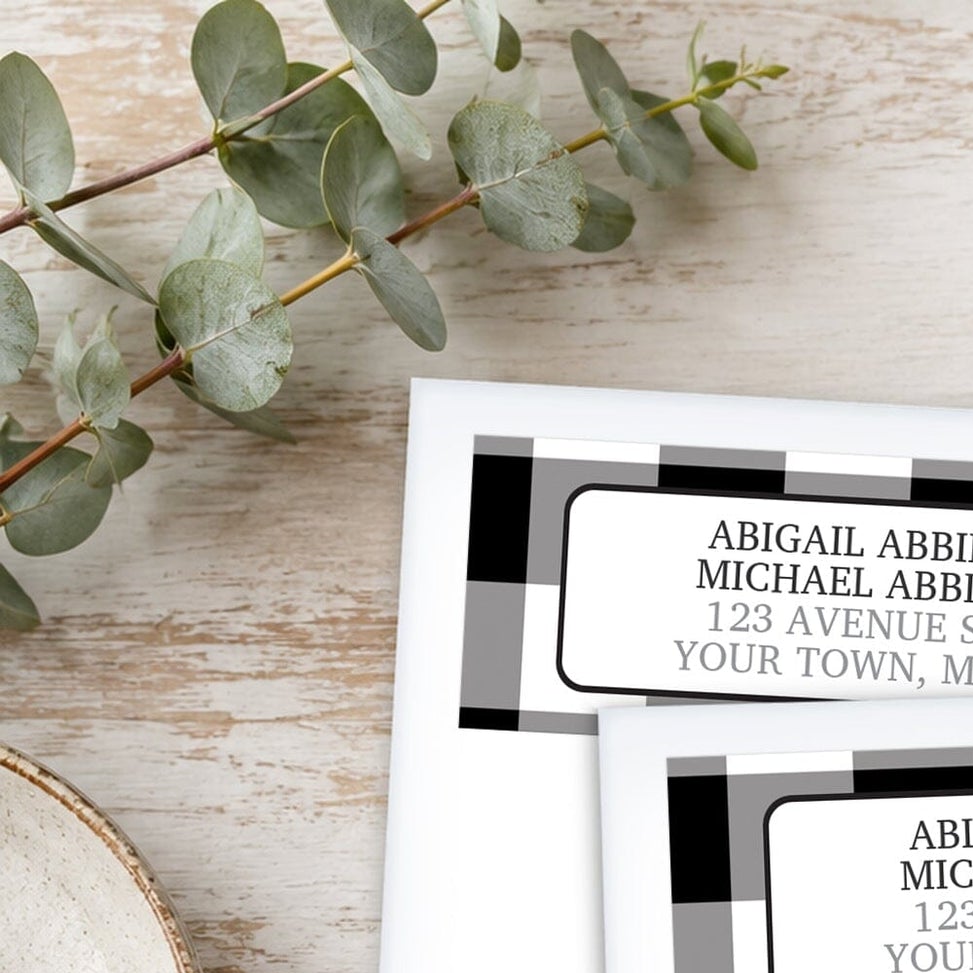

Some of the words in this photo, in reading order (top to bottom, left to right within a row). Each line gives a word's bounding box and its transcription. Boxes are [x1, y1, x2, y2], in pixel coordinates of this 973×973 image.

[708, 520, 865, 557] ABIGAIL
[696, 559, 874, 598] MICHAEL
[707, 601, 773, 634] 123
[786, 606, 947, 643] AVENUE
[674, 640, 782, 675] YOUR
[797, 647, 926, 688] TOWN,
